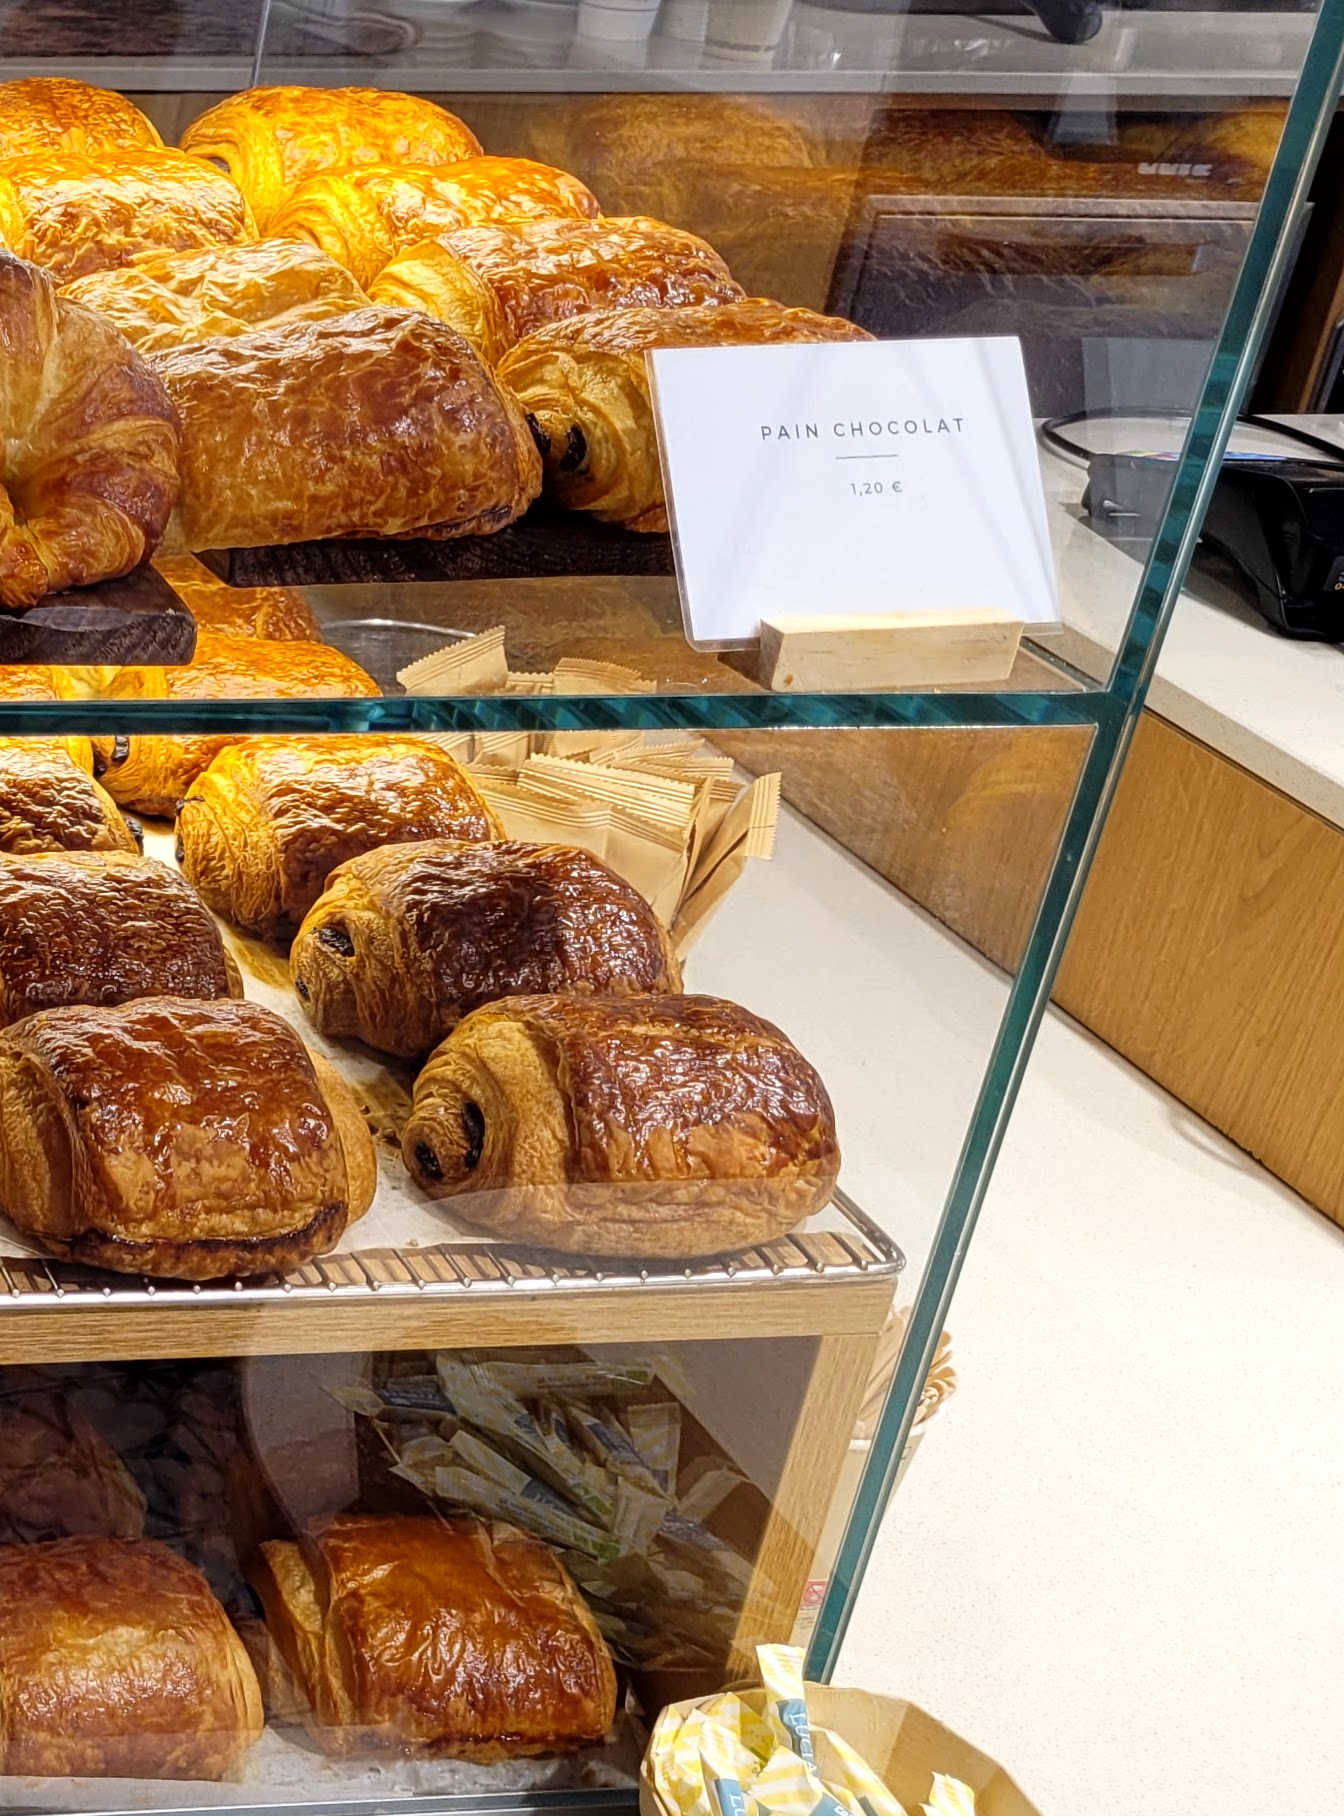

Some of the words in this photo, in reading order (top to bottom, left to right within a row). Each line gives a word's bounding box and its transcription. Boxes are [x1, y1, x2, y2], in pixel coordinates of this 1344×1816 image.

[761, 424, 819, 440] PAIN
[833, 418, 964, 437] CHOCOLAT
[851, 482, 883, 496] 1,20
[892, 482, 903, 493] €
